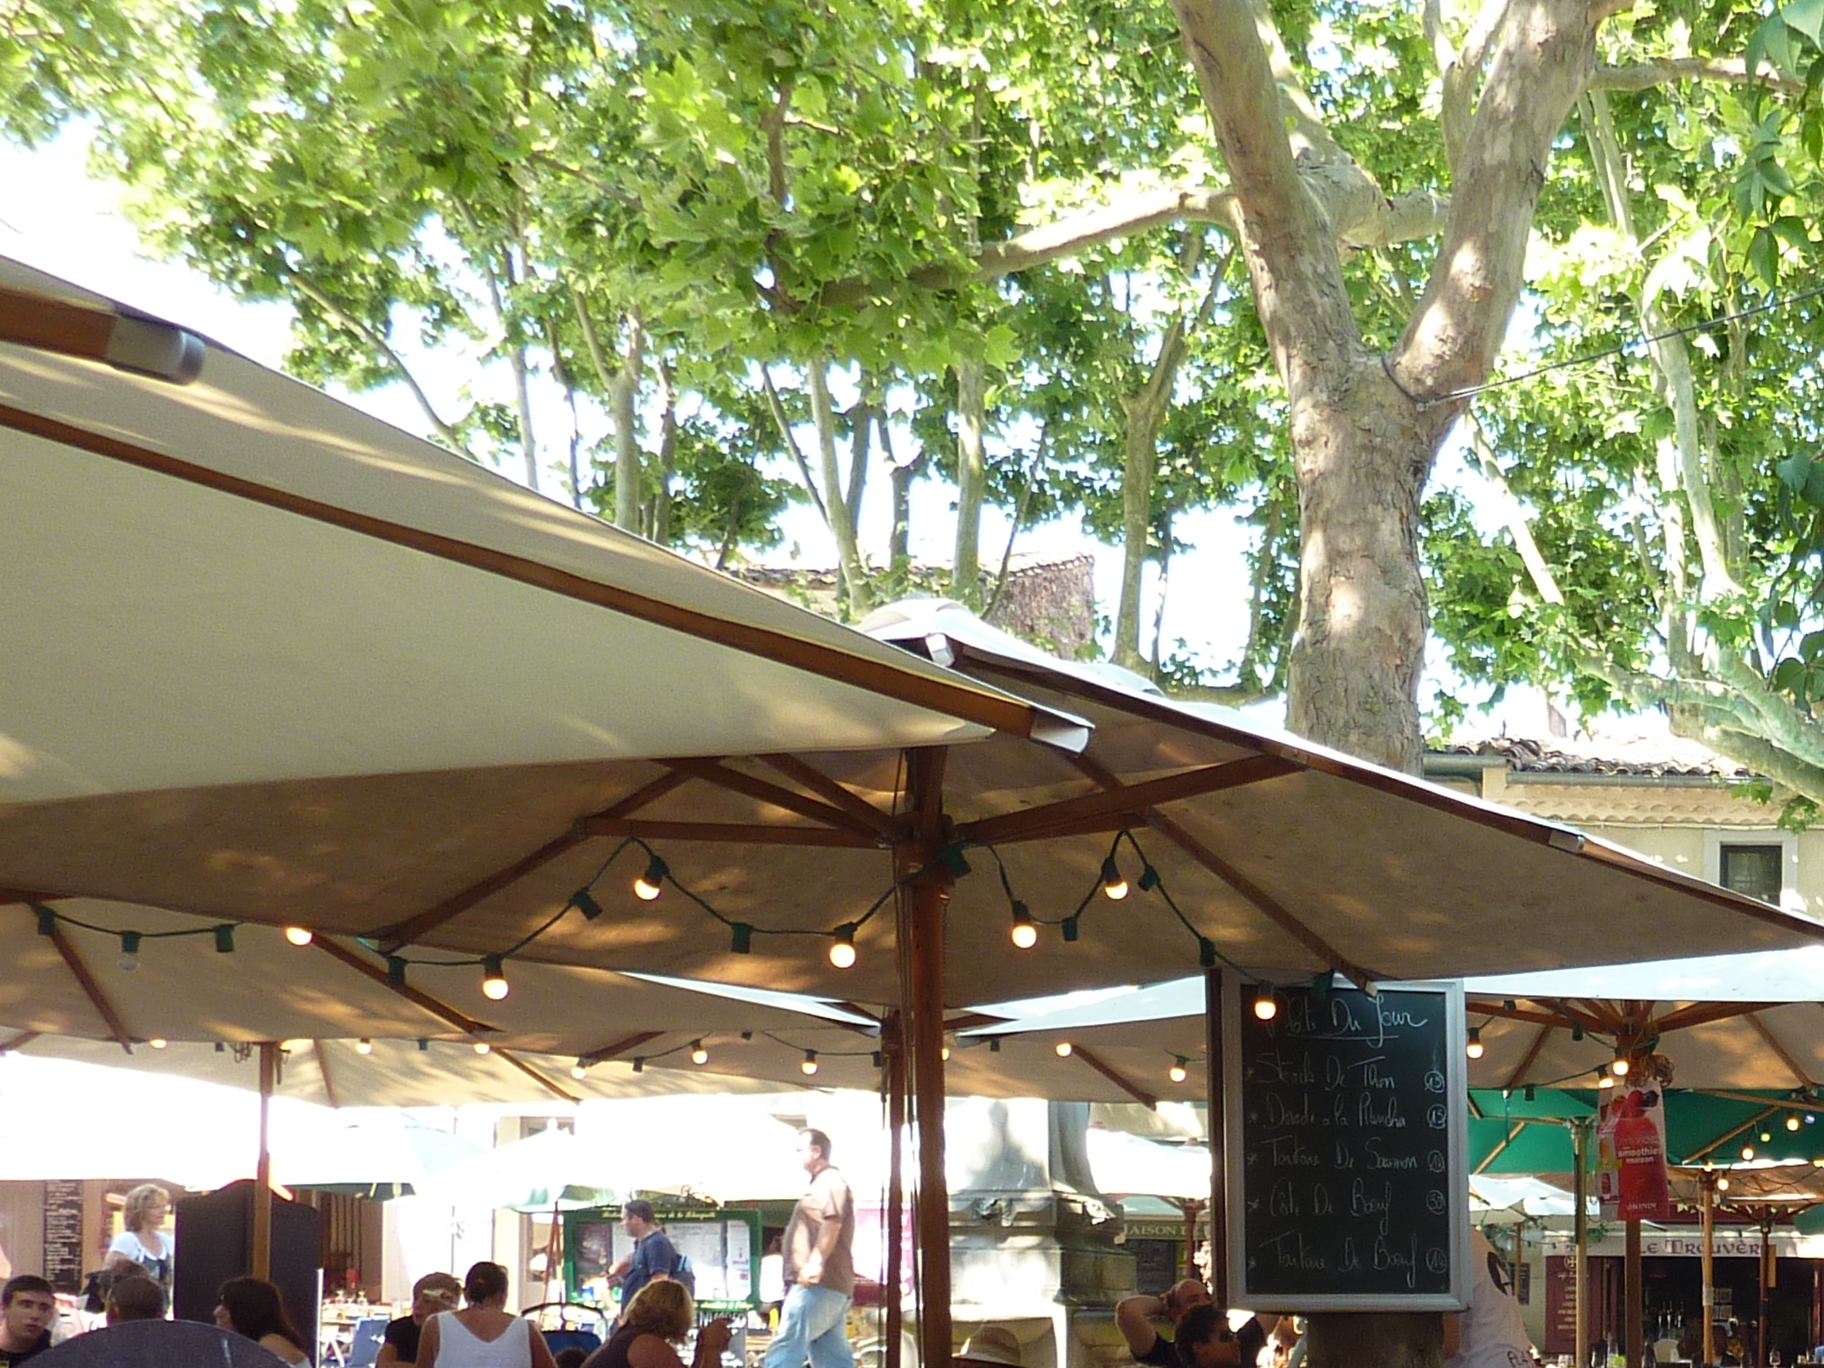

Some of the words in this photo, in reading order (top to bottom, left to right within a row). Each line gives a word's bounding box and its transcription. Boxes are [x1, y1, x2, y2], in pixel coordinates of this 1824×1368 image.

[1331, 998, 1361, 1036] Du
[1366, 994, 1428, 1048] Jour
[1347, 1056, 1395, 1089] Thon
[1333, 1094, 1349, 1128] la
[1359, 1092, 1406, 1128] Plancha
[1261, 1135, 1321, 1168] Tartare
[1366, 1137, 1418, 1169] Saumon
[1313, 1183, 1334, 1216] De
